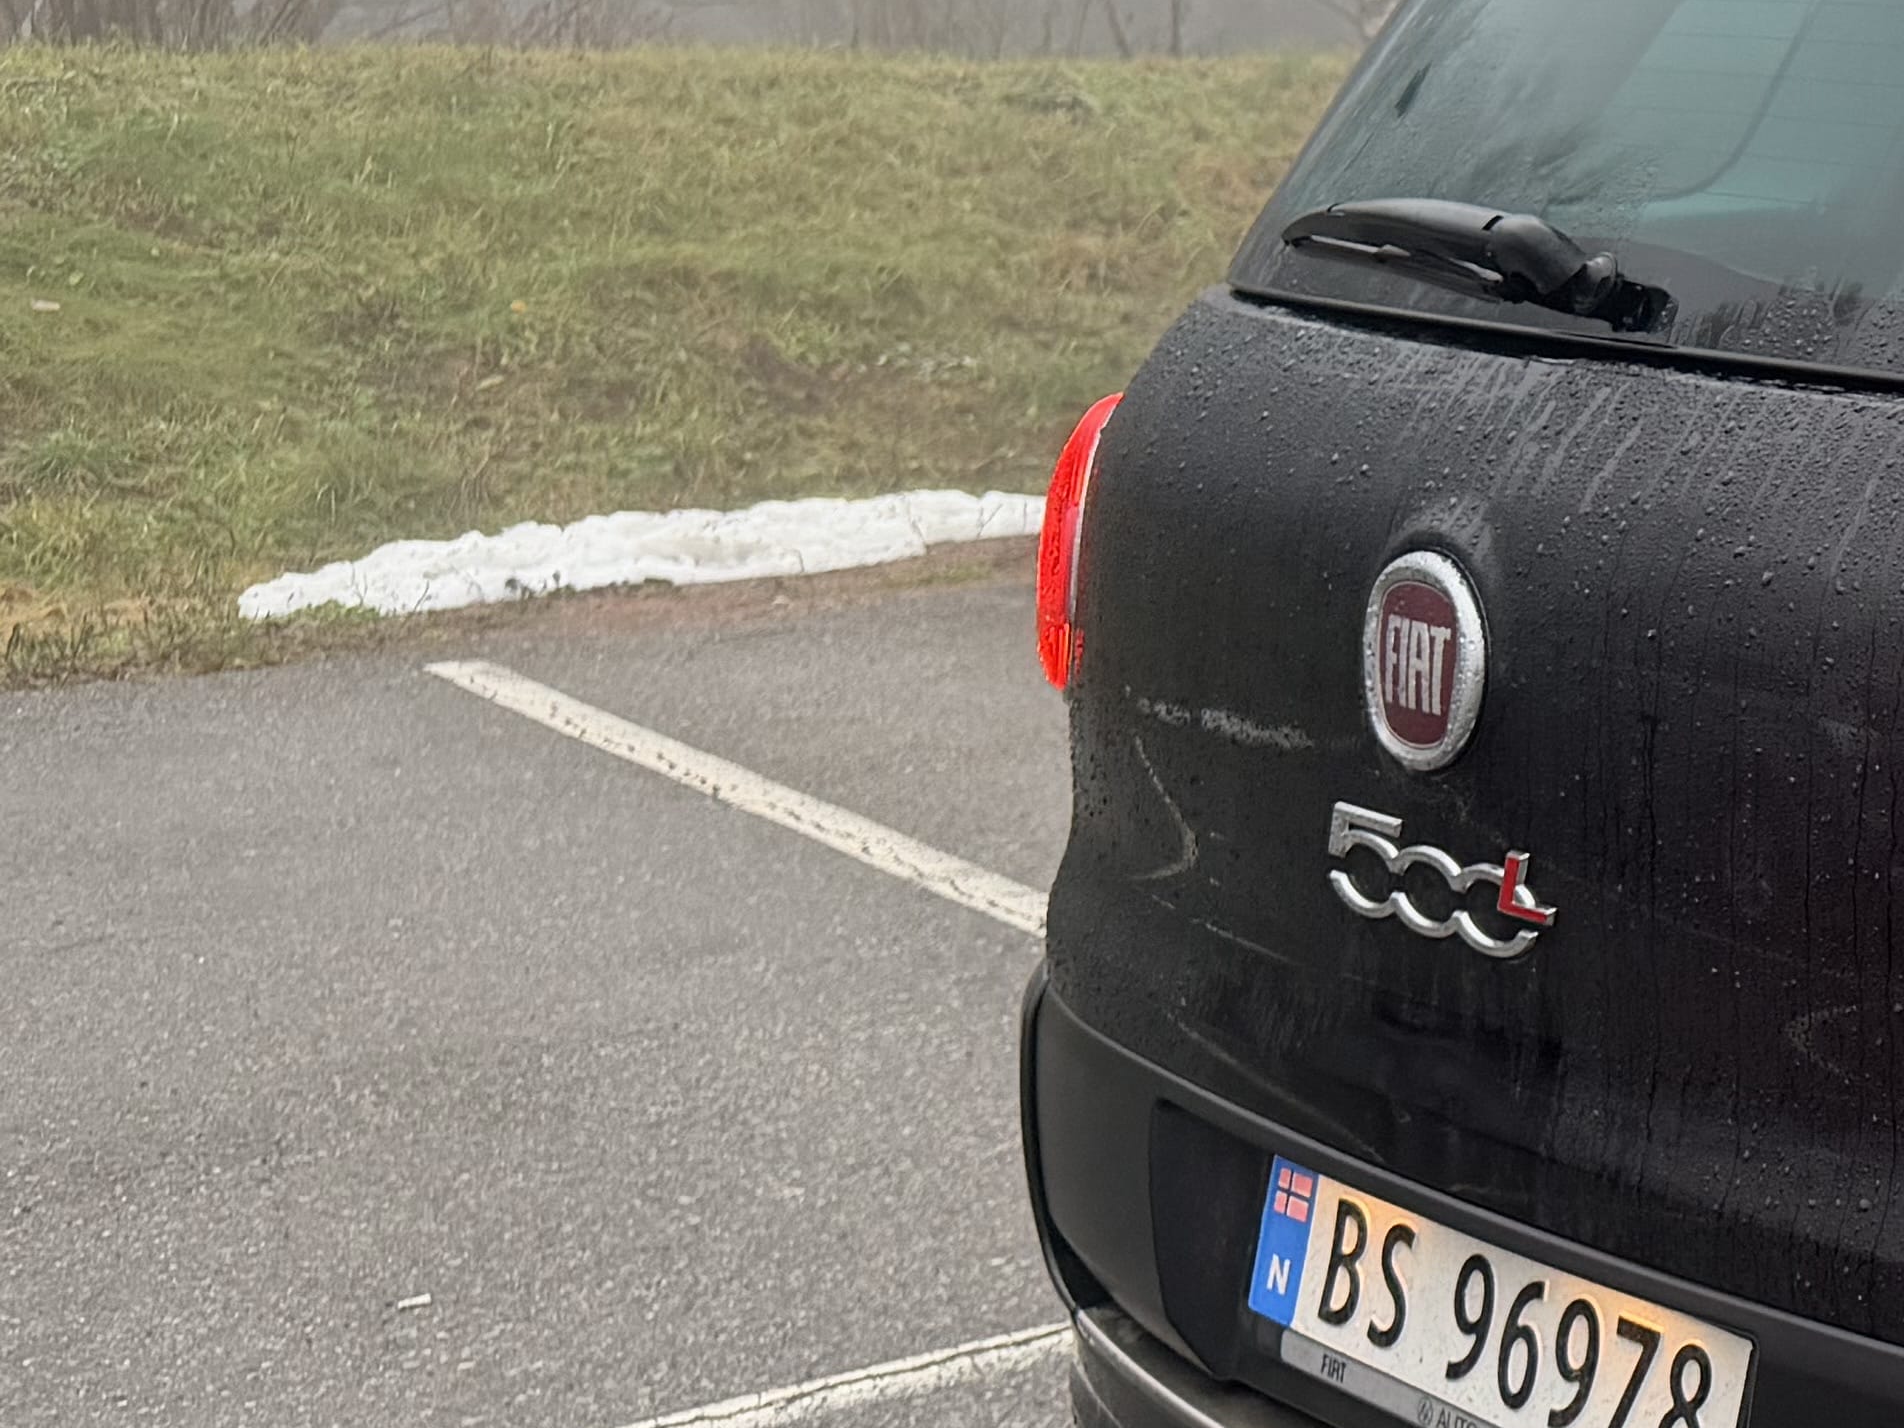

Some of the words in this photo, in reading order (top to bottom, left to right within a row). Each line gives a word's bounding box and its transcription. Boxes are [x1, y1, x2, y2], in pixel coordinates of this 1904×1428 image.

[1385, 614, 1451, 716] FIAT
[1266, 1253, 1289, 1295] N
[1317, 1198, 1416, 1347] BS
[1321, 1354, 1346, 1383] FIAT
